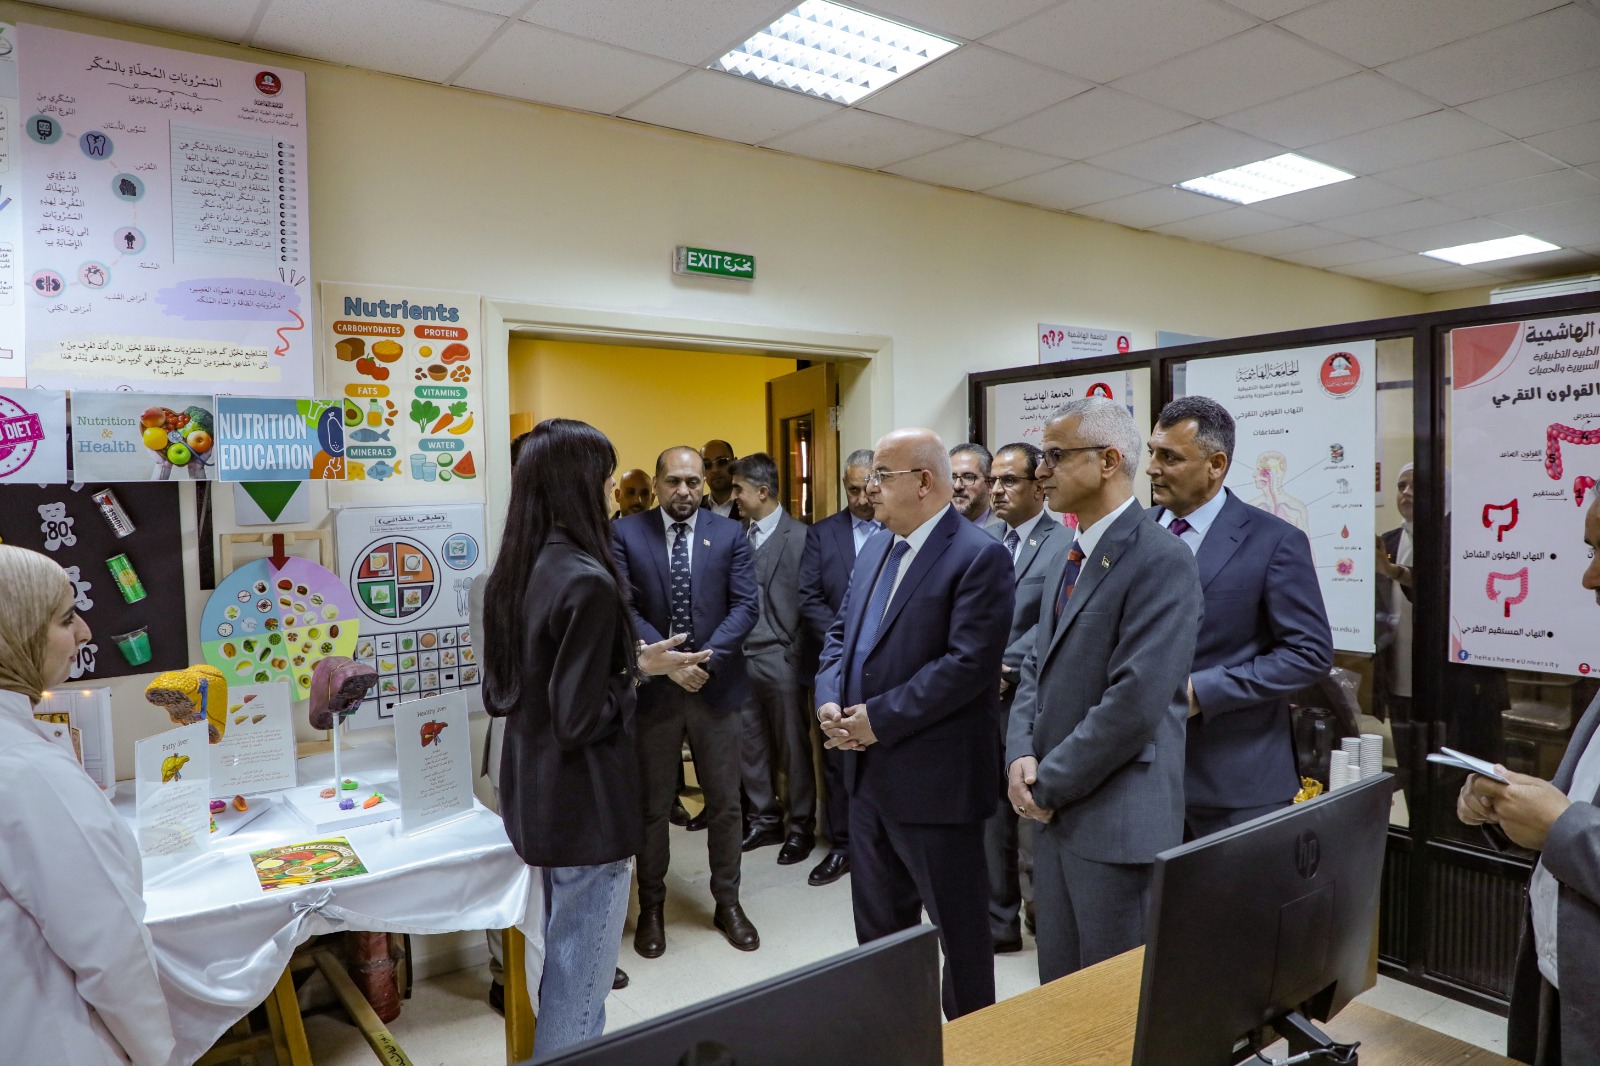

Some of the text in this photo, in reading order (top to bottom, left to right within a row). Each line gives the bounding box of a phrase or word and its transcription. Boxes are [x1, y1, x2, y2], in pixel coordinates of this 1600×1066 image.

[688, 252, 721, 270] EXIT
[344, 296, 459, 322] Nutrients
[337, 324, 400, 334] CARBOHYDRATES
[424, 328, 458, 338] PROTEIN
[1526, 321, 1595, 346] الهاشمية
[357, 387, 378, 395] FATS
[422, 388, 460, 397] VITAMINS
[1024, 388, 1074, 403] الجامعة الهاشمية
[1492, 383, 1600, 408] القولون التقرحي
[1260, 408, 1282, 418] القولون
[77, 416, 136, 426] Nutrition
[220, 413, 307, 440] NUTRITION
[4, 420, 31, 440] DIET
[102, 429, 113, 438] &
[1581, 431, 1588, 441] 4
[79, 440, 136, 453] Health
[350, 448, 392, 456] MINERALS
[221, 444, 313, 470] EDUCATION
[1549, 454, 1556, 463] 5
[1576, 488, 1583, 498] 1
[47, 521, 68, 540] 80
[1463, 550, 1544, 562] التهاب القولون الشامل
[1462, 625, 1545, 639] التهاب المستقيم التقرحي
